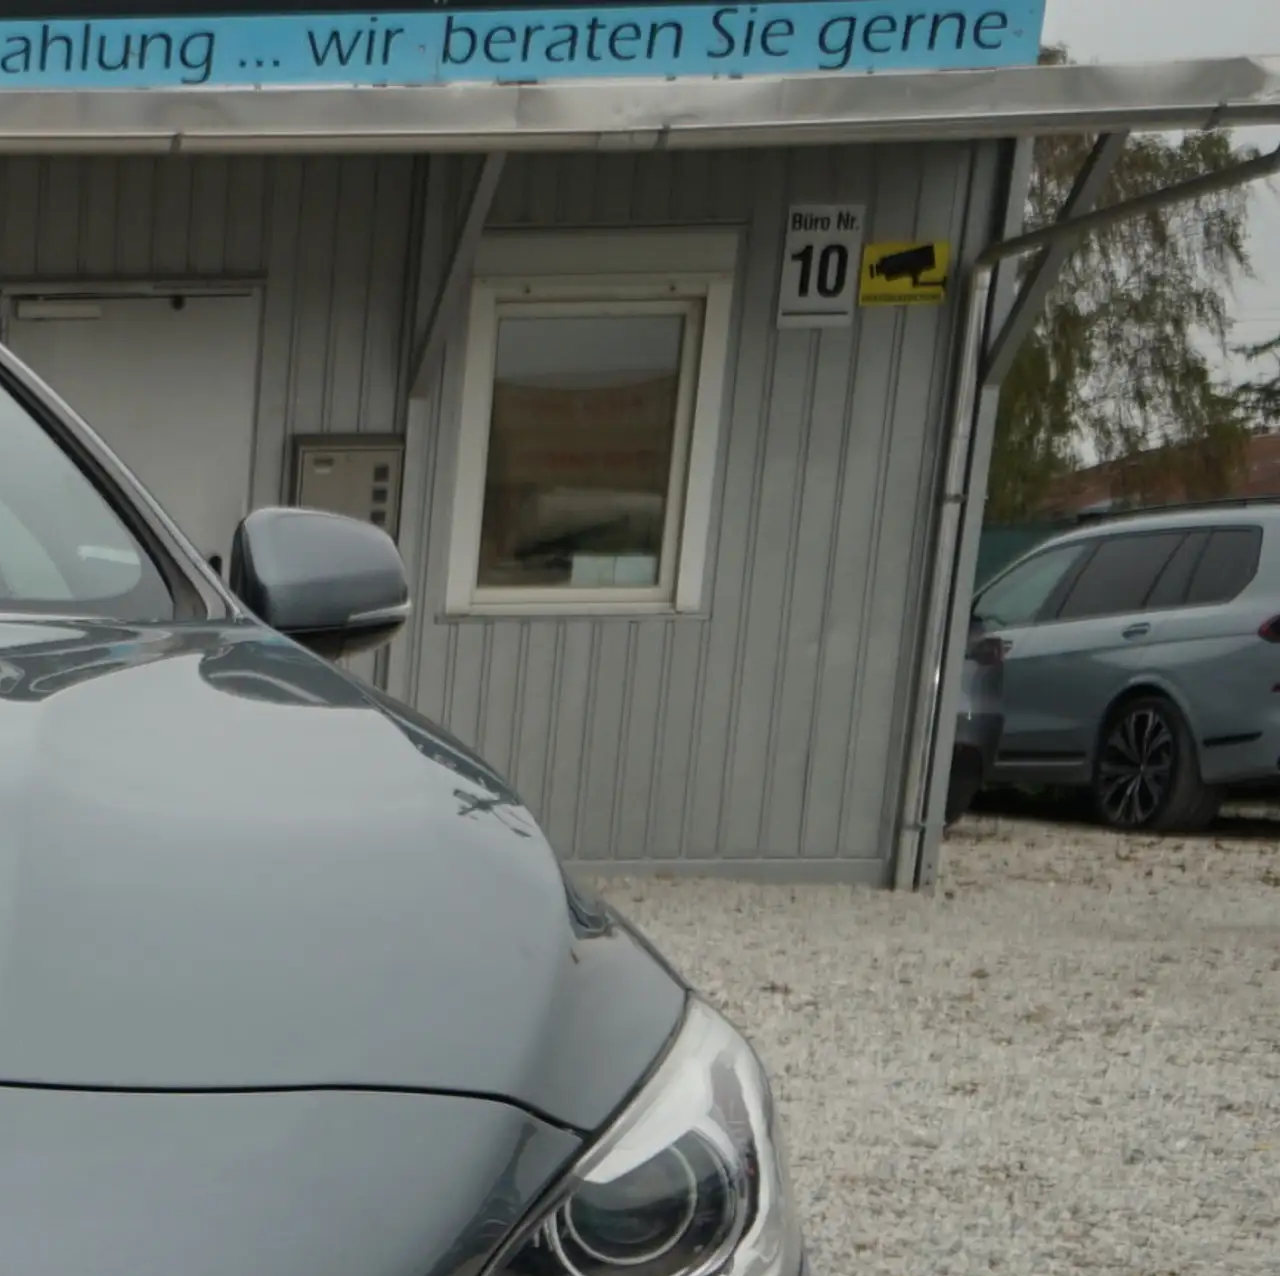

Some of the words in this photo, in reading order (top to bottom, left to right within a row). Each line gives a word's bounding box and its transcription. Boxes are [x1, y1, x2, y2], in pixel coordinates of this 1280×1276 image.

[306, 15, 404, 67] wir
[441, 15, 684, 64] beraten
[706, 7, 796, 59] Sie
[818, 8, 1009, 71] gerne
[792, 211, 831, 232] Büro
[836, 211, 860, 231] Nr.
[791, 243, 848, 298] 10
